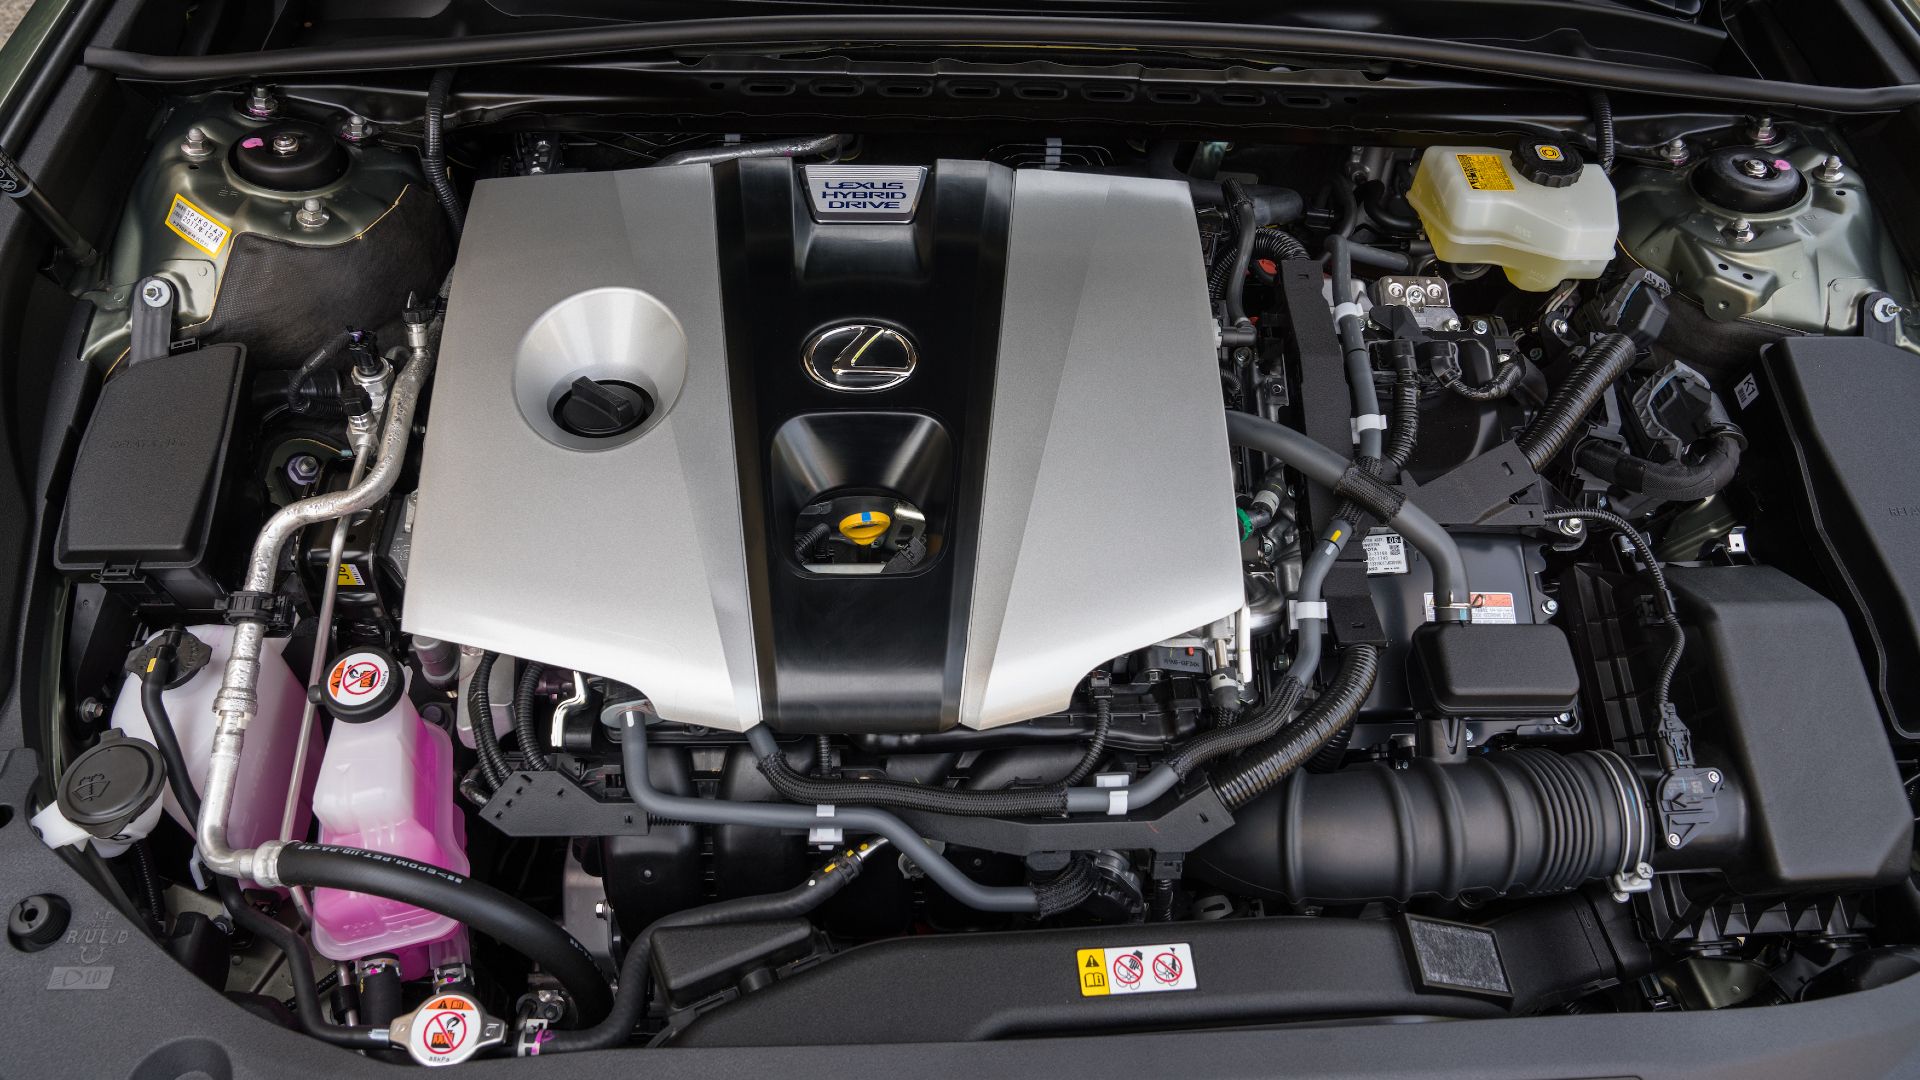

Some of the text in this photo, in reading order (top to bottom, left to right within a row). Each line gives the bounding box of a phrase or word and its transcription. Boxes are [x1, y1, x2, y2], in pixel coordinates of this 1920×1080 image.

[825, 182, 904, 190] LEXUS
[822, 191, 906, 200] HYBRID
[828, 201, 900, 209] DRIVE
[1743, 377, 1756, 396] K1
[1389, 536, 1399, 544] 06
